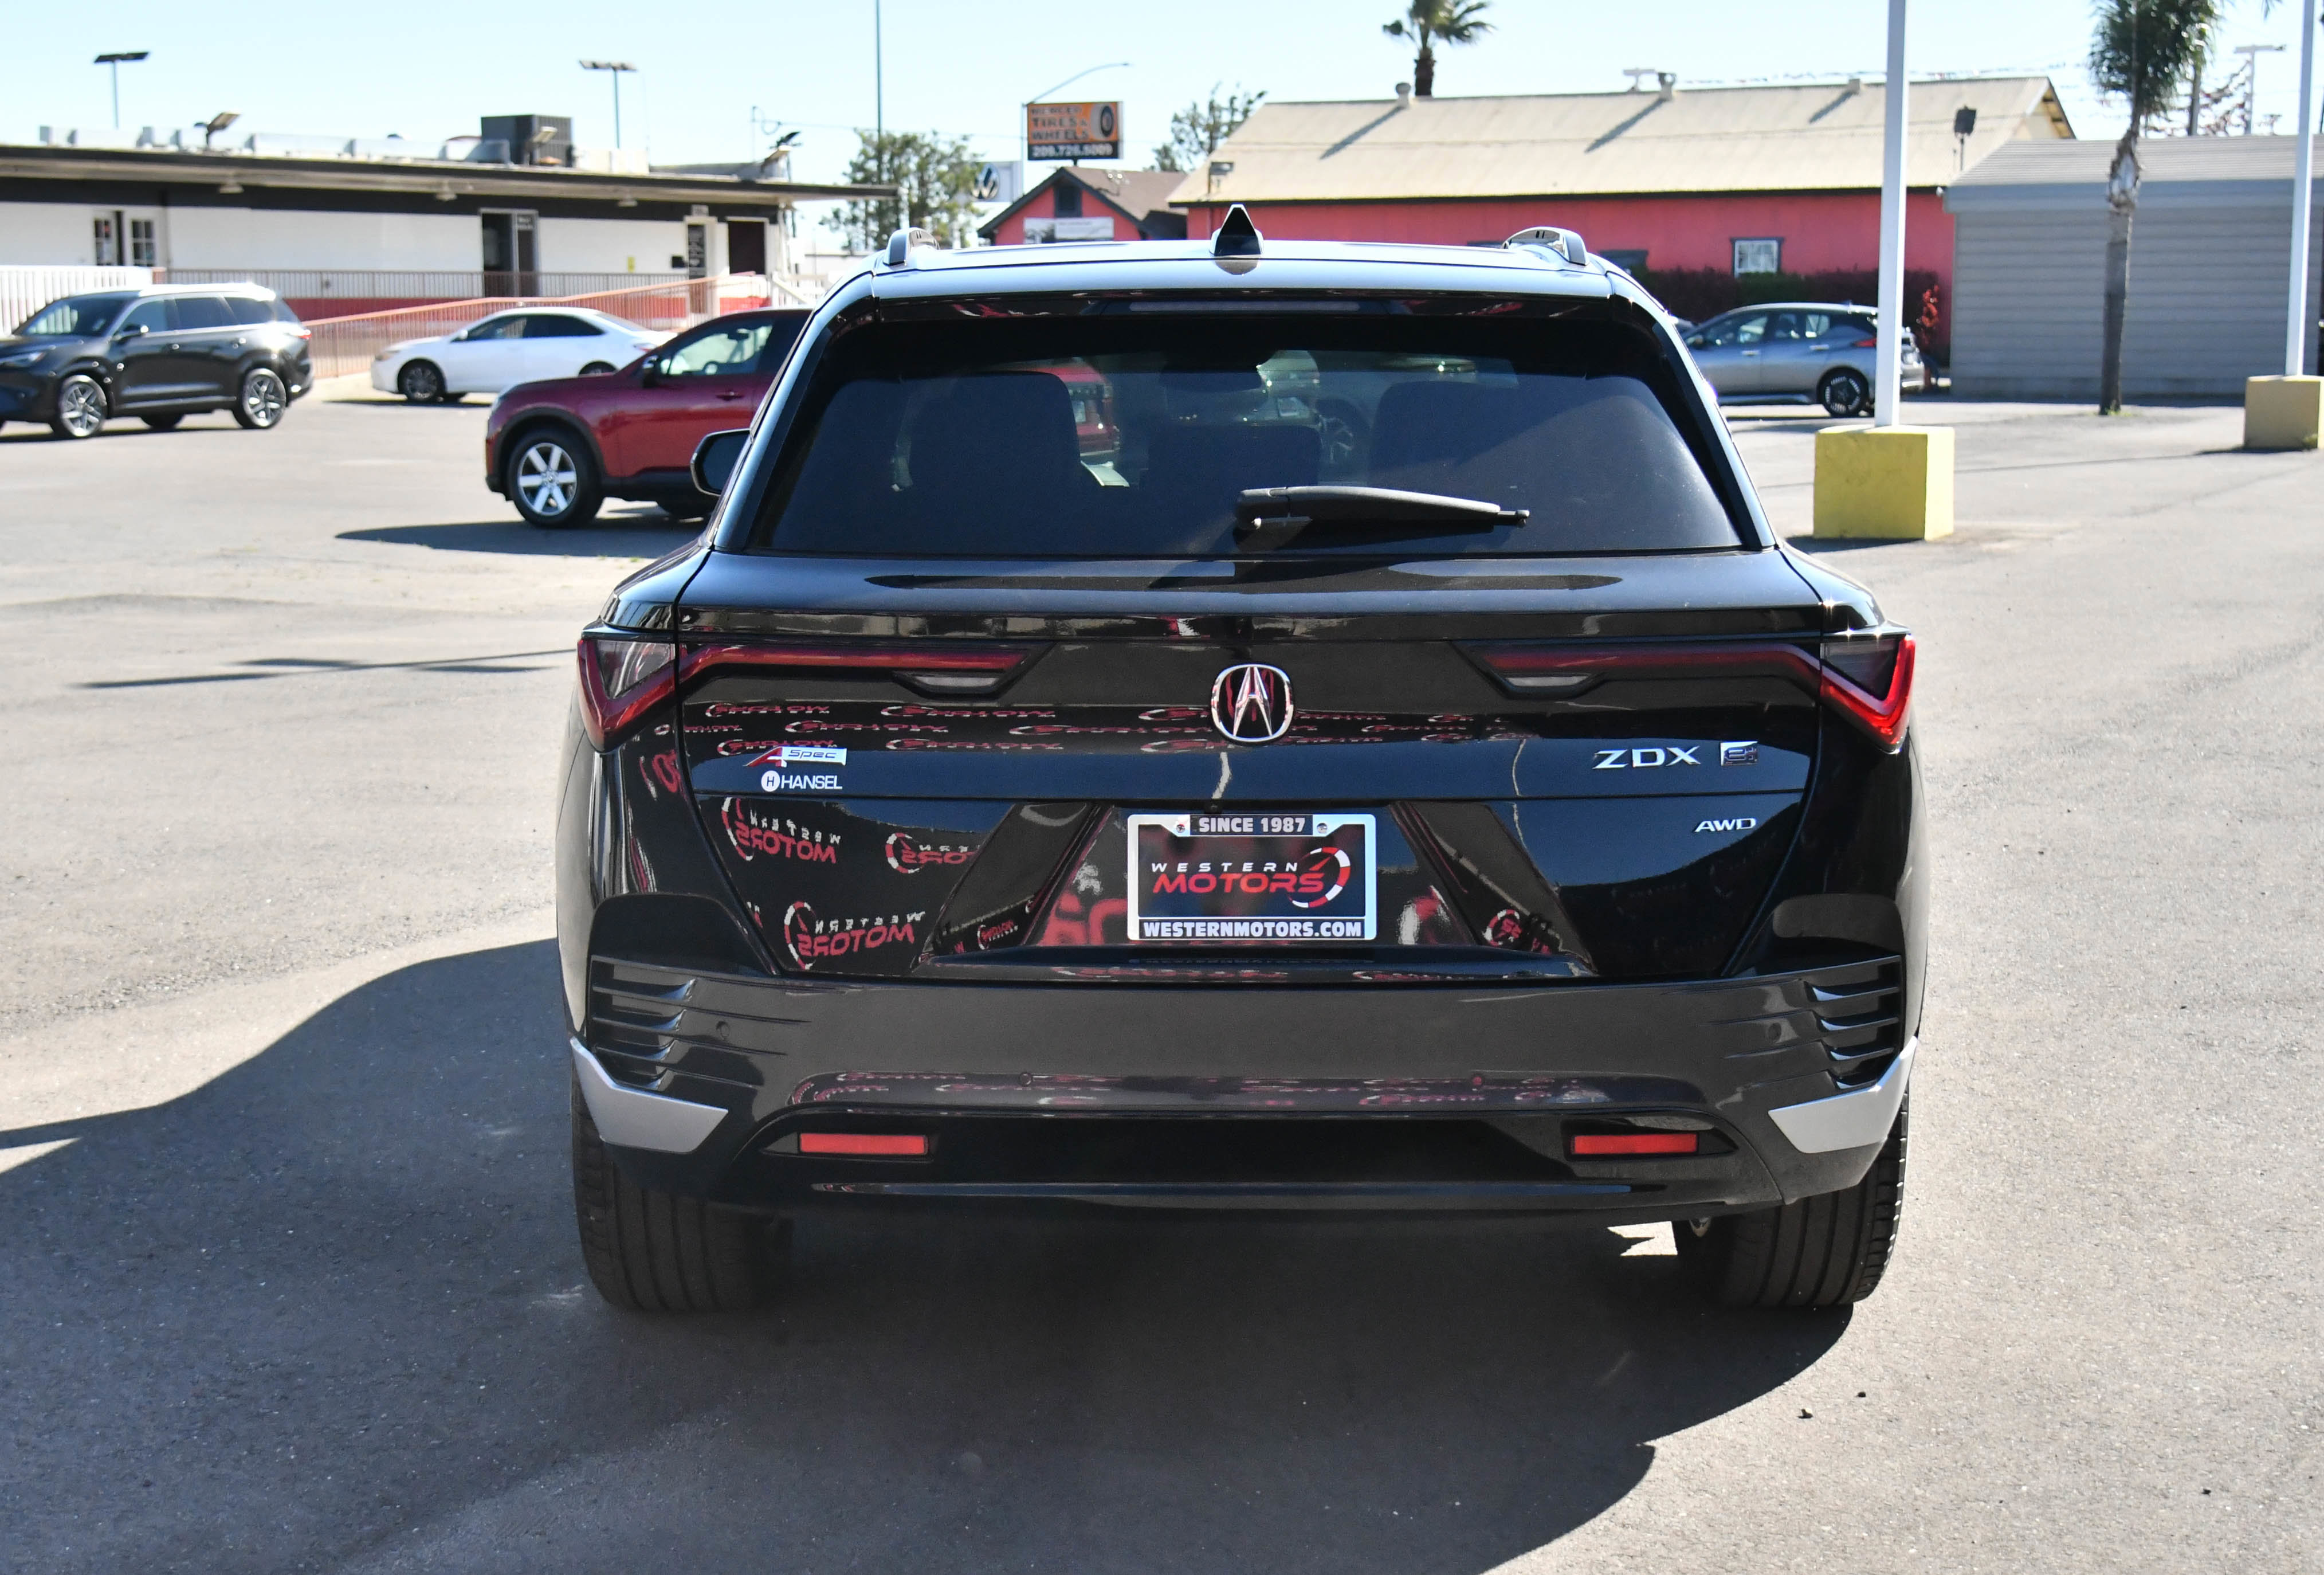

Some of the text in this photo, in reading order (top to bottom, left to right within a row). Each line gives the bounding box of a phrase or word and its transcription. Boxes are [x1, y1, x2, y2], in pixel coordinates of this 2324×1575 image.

[1592, 746, 1701, 769] ZDX
[780, 775, 843, 790] HANSEL
[1198, 817, 1306, 833] SINCE 1987
[1694, 818, 1757, 832] AWD
[1151, 862, 1298, 872] WESTERN
[1152, 873, 1325, 894] MOTORS
[1143, 921, 1362, 938] WESTERNMOTORS.COM
